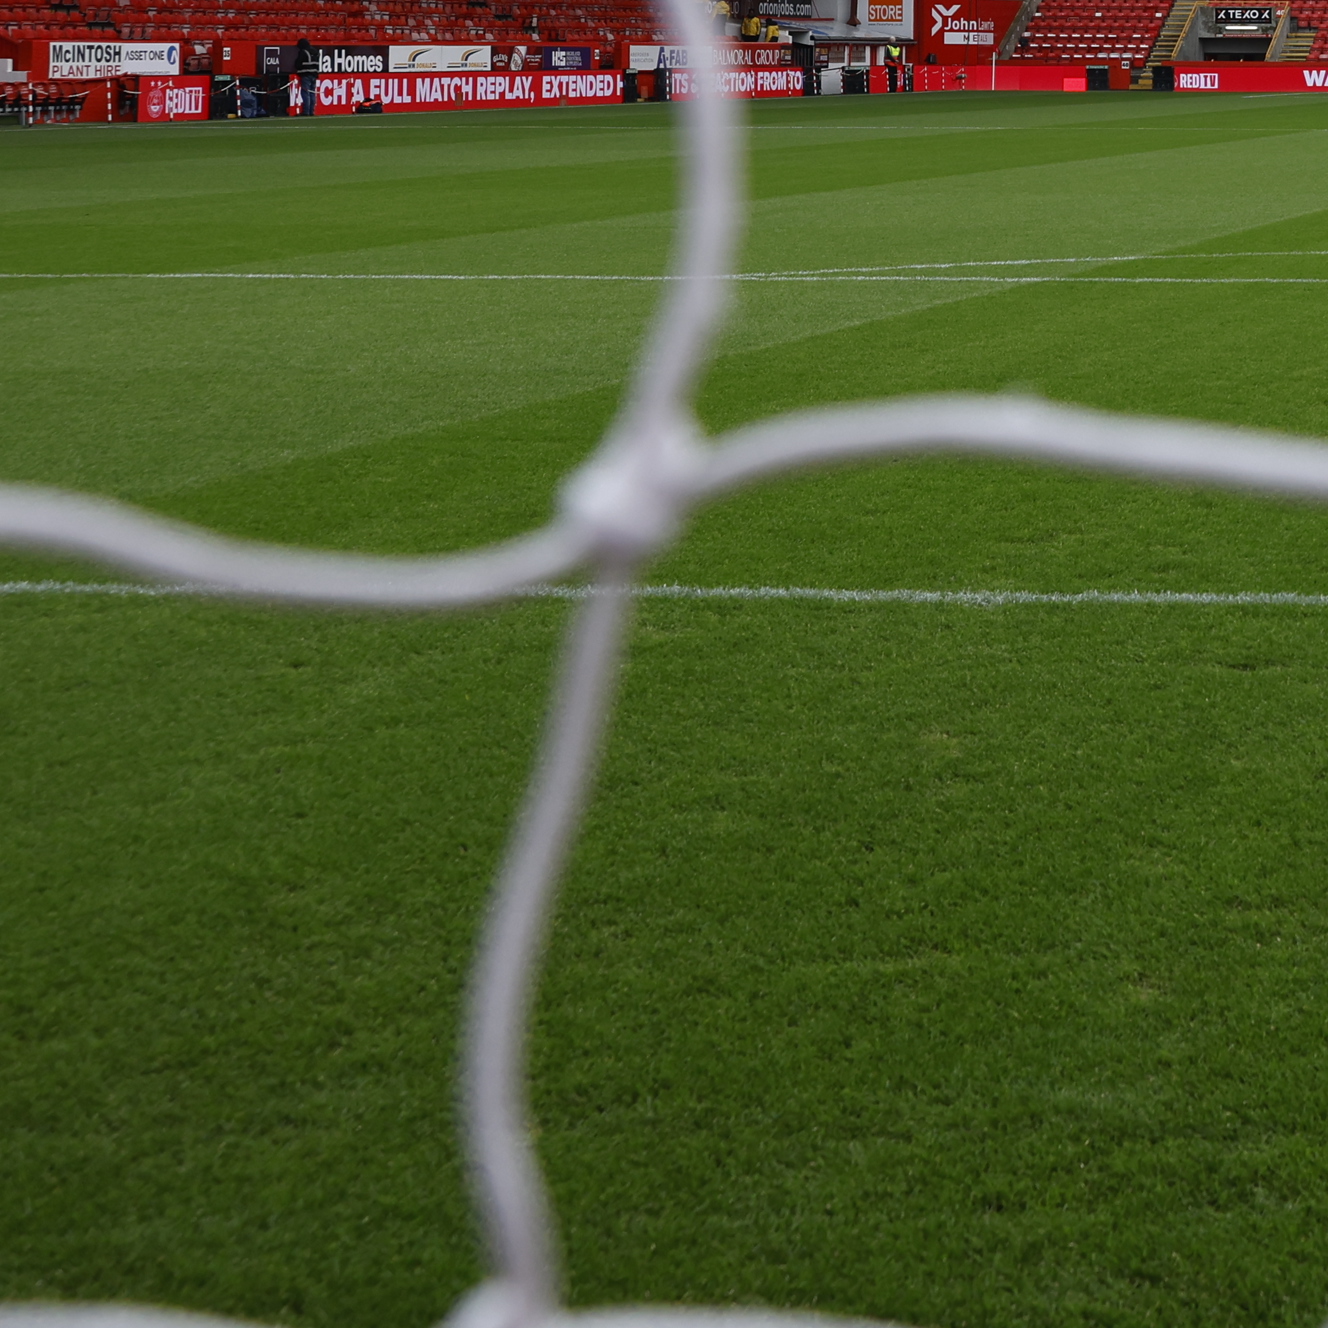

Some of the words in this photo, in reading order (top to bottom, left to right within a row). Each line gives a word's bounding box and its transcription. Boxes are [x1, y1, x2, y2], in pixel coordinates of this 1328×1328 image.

[758, 0, 812, 17] orionjobs.com
[869, 4, 902, 20] STORE
[1228, 10, 1259, 19] TEXO
[943, 18, 977, 31] John
[52, 44, 122, 63] McINTOSH
[124, 50, 148, 61] ASSET
[149, 50, 165, 61] ONE
[266, 57, 280, 66] CALA
[334, 49, 383, 73] Homes
[712, 49, 753, 65] BALMORAL
[755, 50, 780, 65] GROUP
[52, 65, 91, 77] PLANT
[94, 65, 122, 77] HIRE
[757, 71, 786, 91] FROM
[370, 78, 411, 105] FULL
[415, 76, 473, 103] MATCH
[476, 76, 535, 103] REPLAY,
[542, 74, 614, 98] EXTENDED
